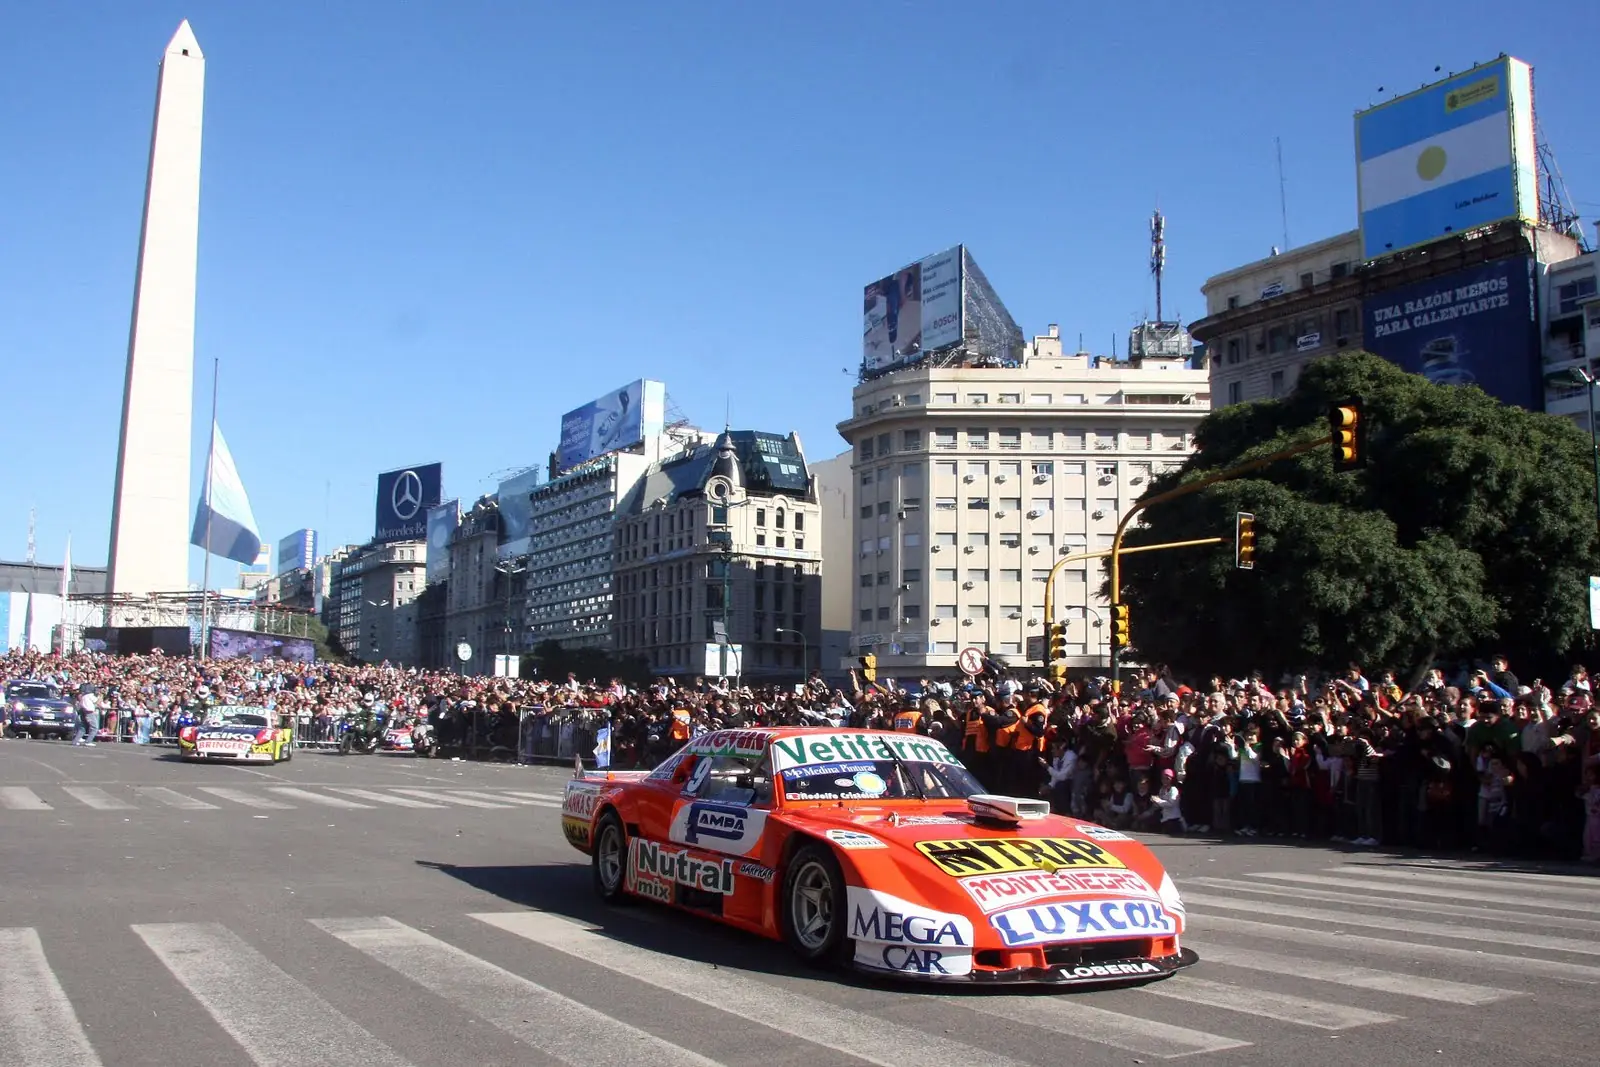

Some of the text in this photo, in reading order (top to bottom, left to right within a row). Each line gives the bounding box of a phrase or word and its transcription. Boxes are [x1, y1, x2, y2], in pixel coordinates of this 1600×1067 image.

[1374, 276, 1508, 322] UNA RAZÓN MENOS
[933, 312, 958, 330] BOSCH
[1375, 293, 1509, 338] PARA CALENTARTE
[377, 521, 427, 539] Mercedes-Be
[197, 731, 255, 742] KEIKO
[775, 735, 959, 765] Vetifarma
[687, 757, 713, 792] 9
[802, 766, 840, 776] Medina
[840, 764, 876, 773] Pinturas
[801, 792, 838, 800] Rodolfo
[639, 839, 735, 896] Nutral
[638, 878, 671, 903] mix
[968, 873, 1147, 902] MONTENEGRO
[852, 903, 968, 946] MEGA
[882, 945, 952, 975] CAR
[1060, 962, 1160, 979] LOBERIA
